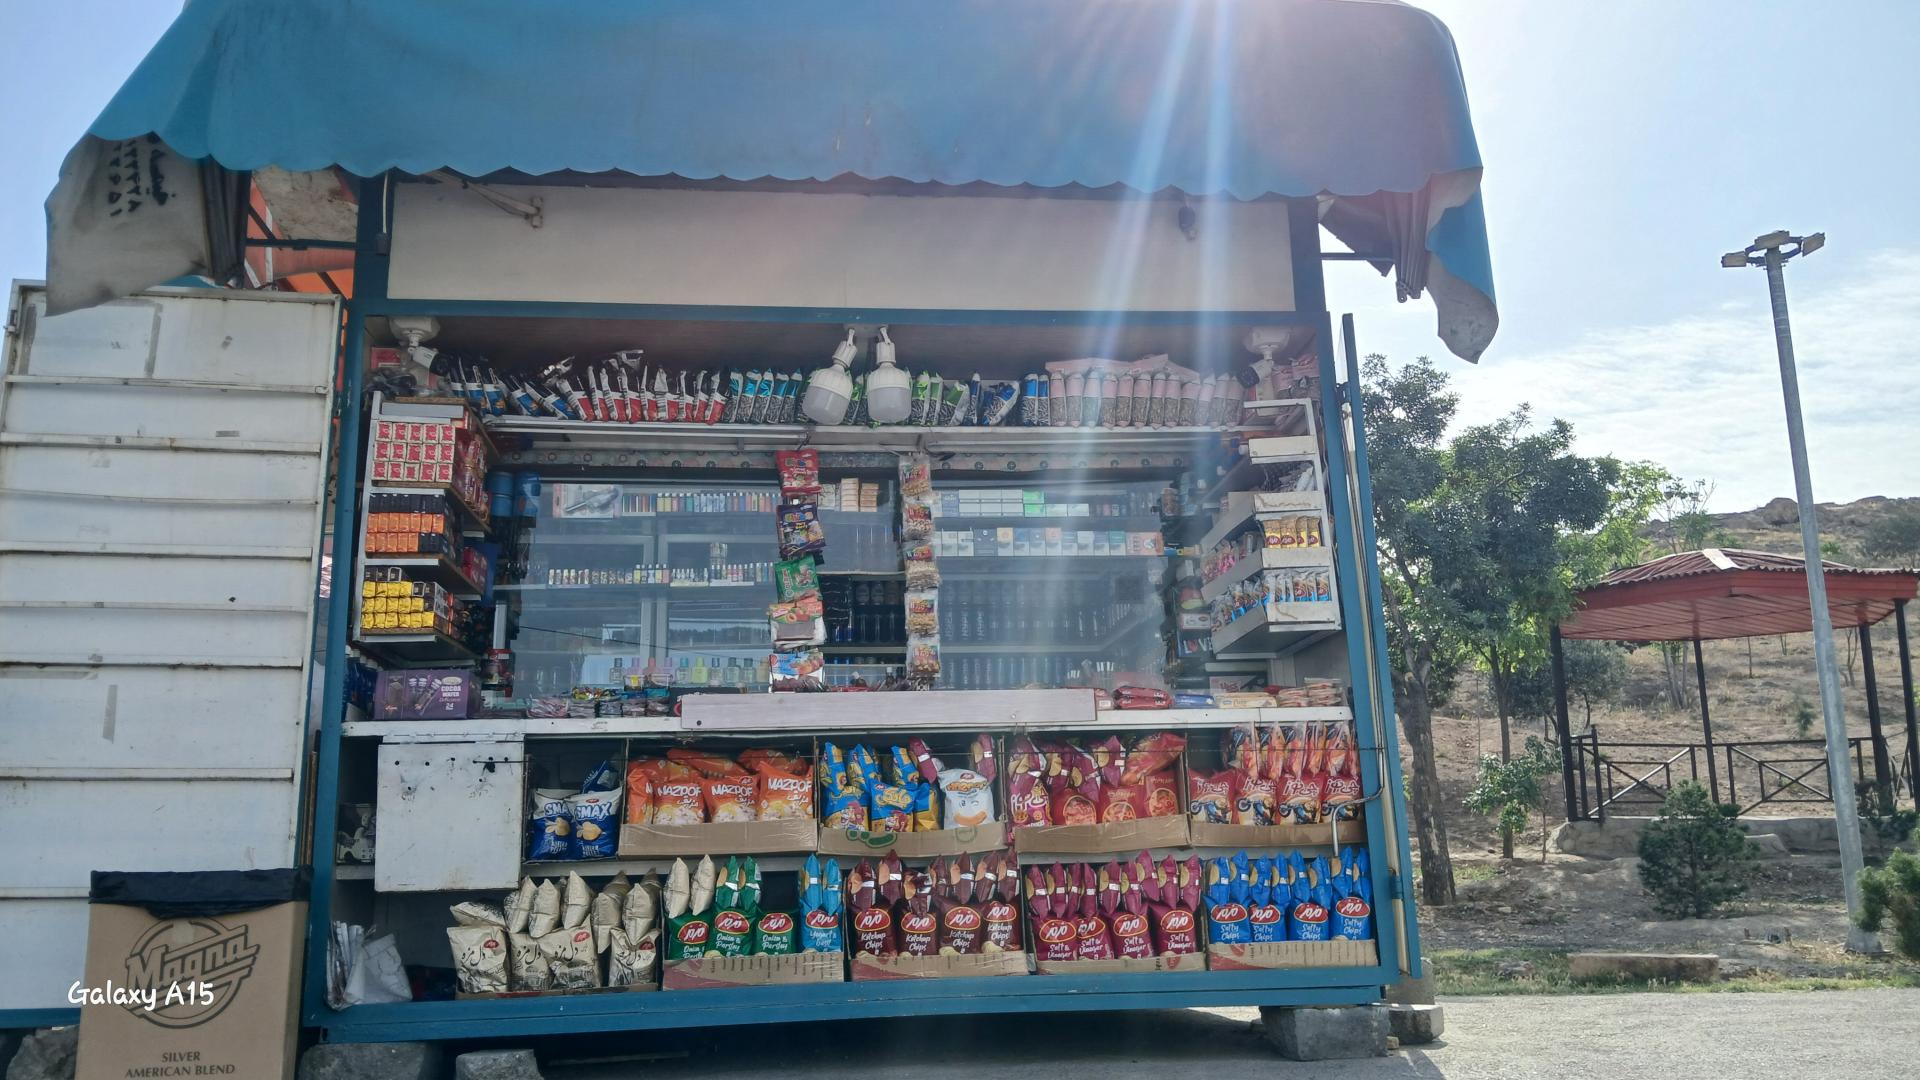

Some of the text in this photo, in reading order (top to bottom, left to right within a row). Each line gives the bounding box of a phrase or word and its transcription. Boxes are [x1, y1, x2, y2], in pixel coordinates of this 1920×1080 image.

[768, 778, 812, 792] MAZPOF
[657, 785, 702, 797] MAZPOF
[711, 784, 752, 797] MAZPOF
[544, 802, 569, 816] SMA
[1343, 927, 1362, 935] Chips
[716, 933, 735, 942] Onion
[762, 934, 781, 942] Onion
[990, 932, 1009, 940] Chips
[1170, 933, 1184, 942] Salt
[1221, 932, 1239, 940] Chips
[1254, 933, 1273, 941] Chips
[1302, 932, 1321, 941] Chips
[865, 941, 883, 949] Chips
[952, 939, 970, 947] Chips
[1081, 938, 1094, 947] Salt
[1124, 936, 1138, 946] Salt
[909, 943, 926, 951] Chips
[1049, 943, 1064, 952] Salt
[125, 926, 260, 1003] Magna
[162, 1052, 200, 1063] SILVER
[125, 1064, 235, 1079] AMERICAN BLEND
